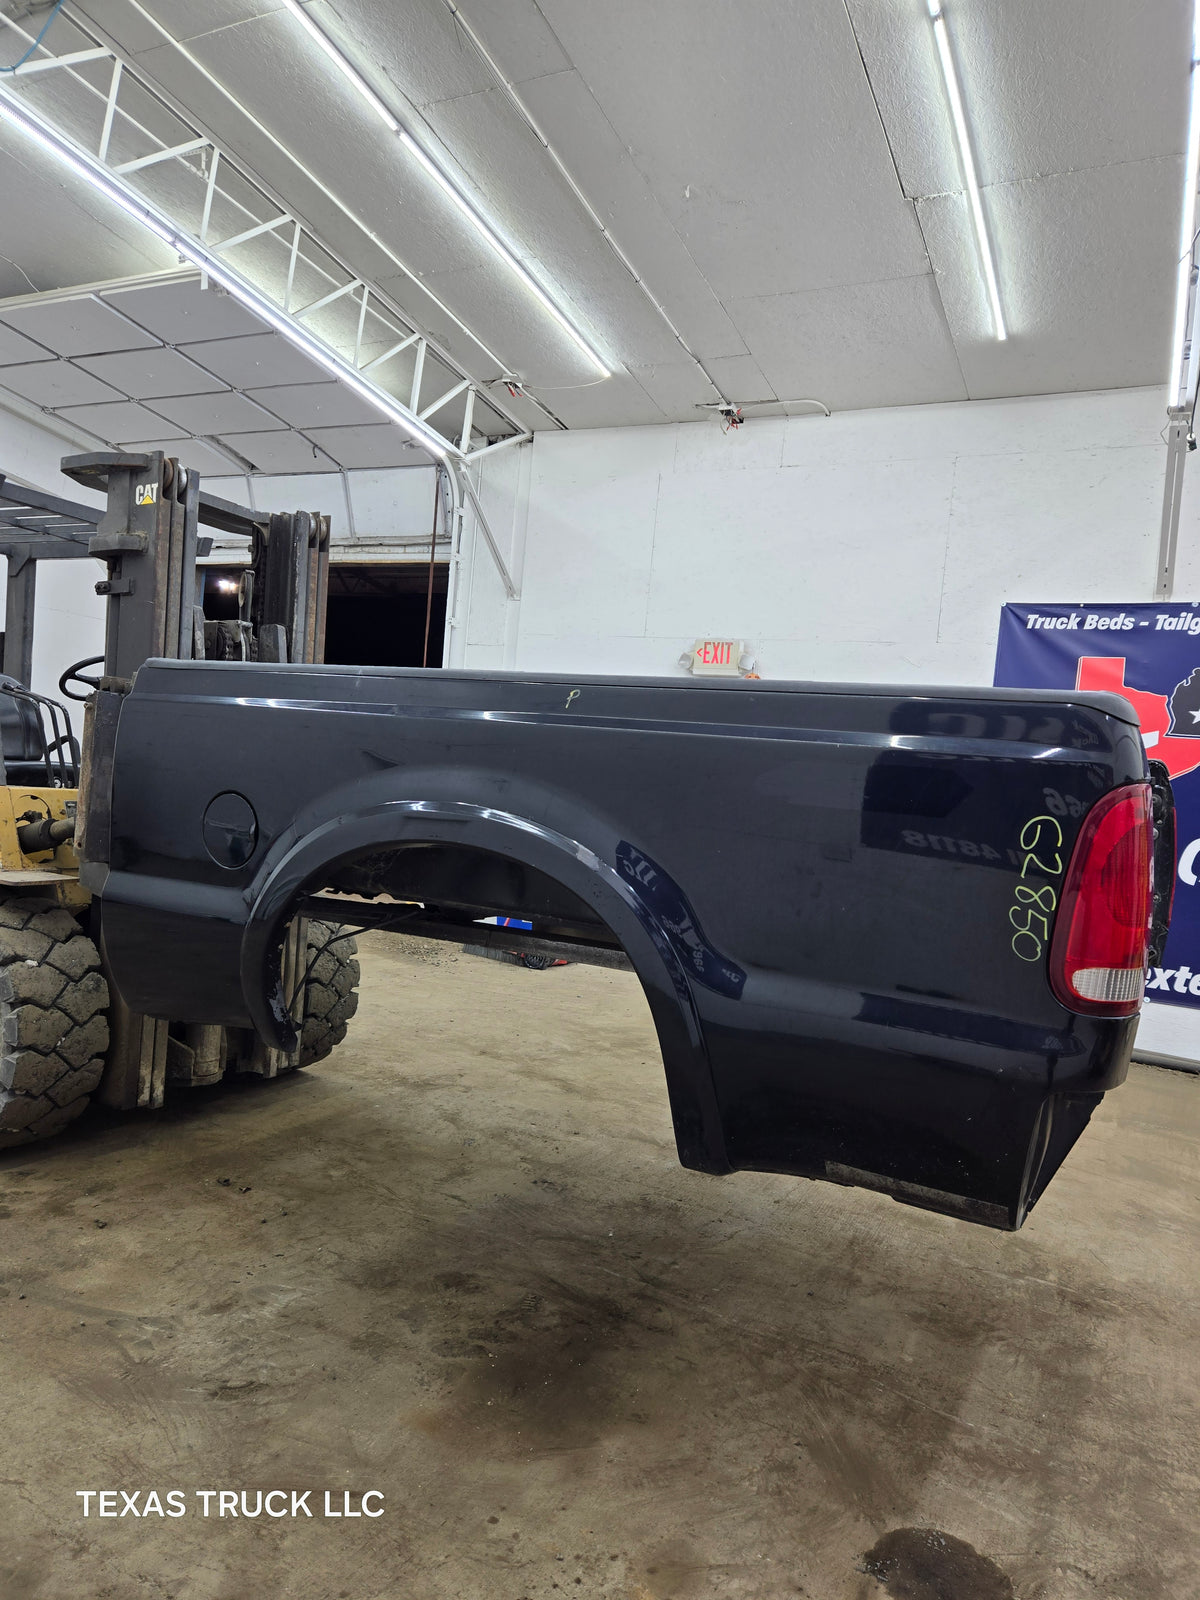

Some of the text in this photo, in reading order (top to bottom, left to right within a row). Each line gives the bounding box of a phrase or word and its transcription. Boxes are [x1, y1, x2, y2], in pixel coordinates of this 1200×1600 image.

[135, 482, 159, 505] CAT
[1026, 613, 1082, 630] Truck
[1083, 613, 1135, 630] Beds
[1155, 612, 1200, 636] Tailg
[702, 641, 734, 664] EXIT
[1009, 815, 1063, 962] 62850
